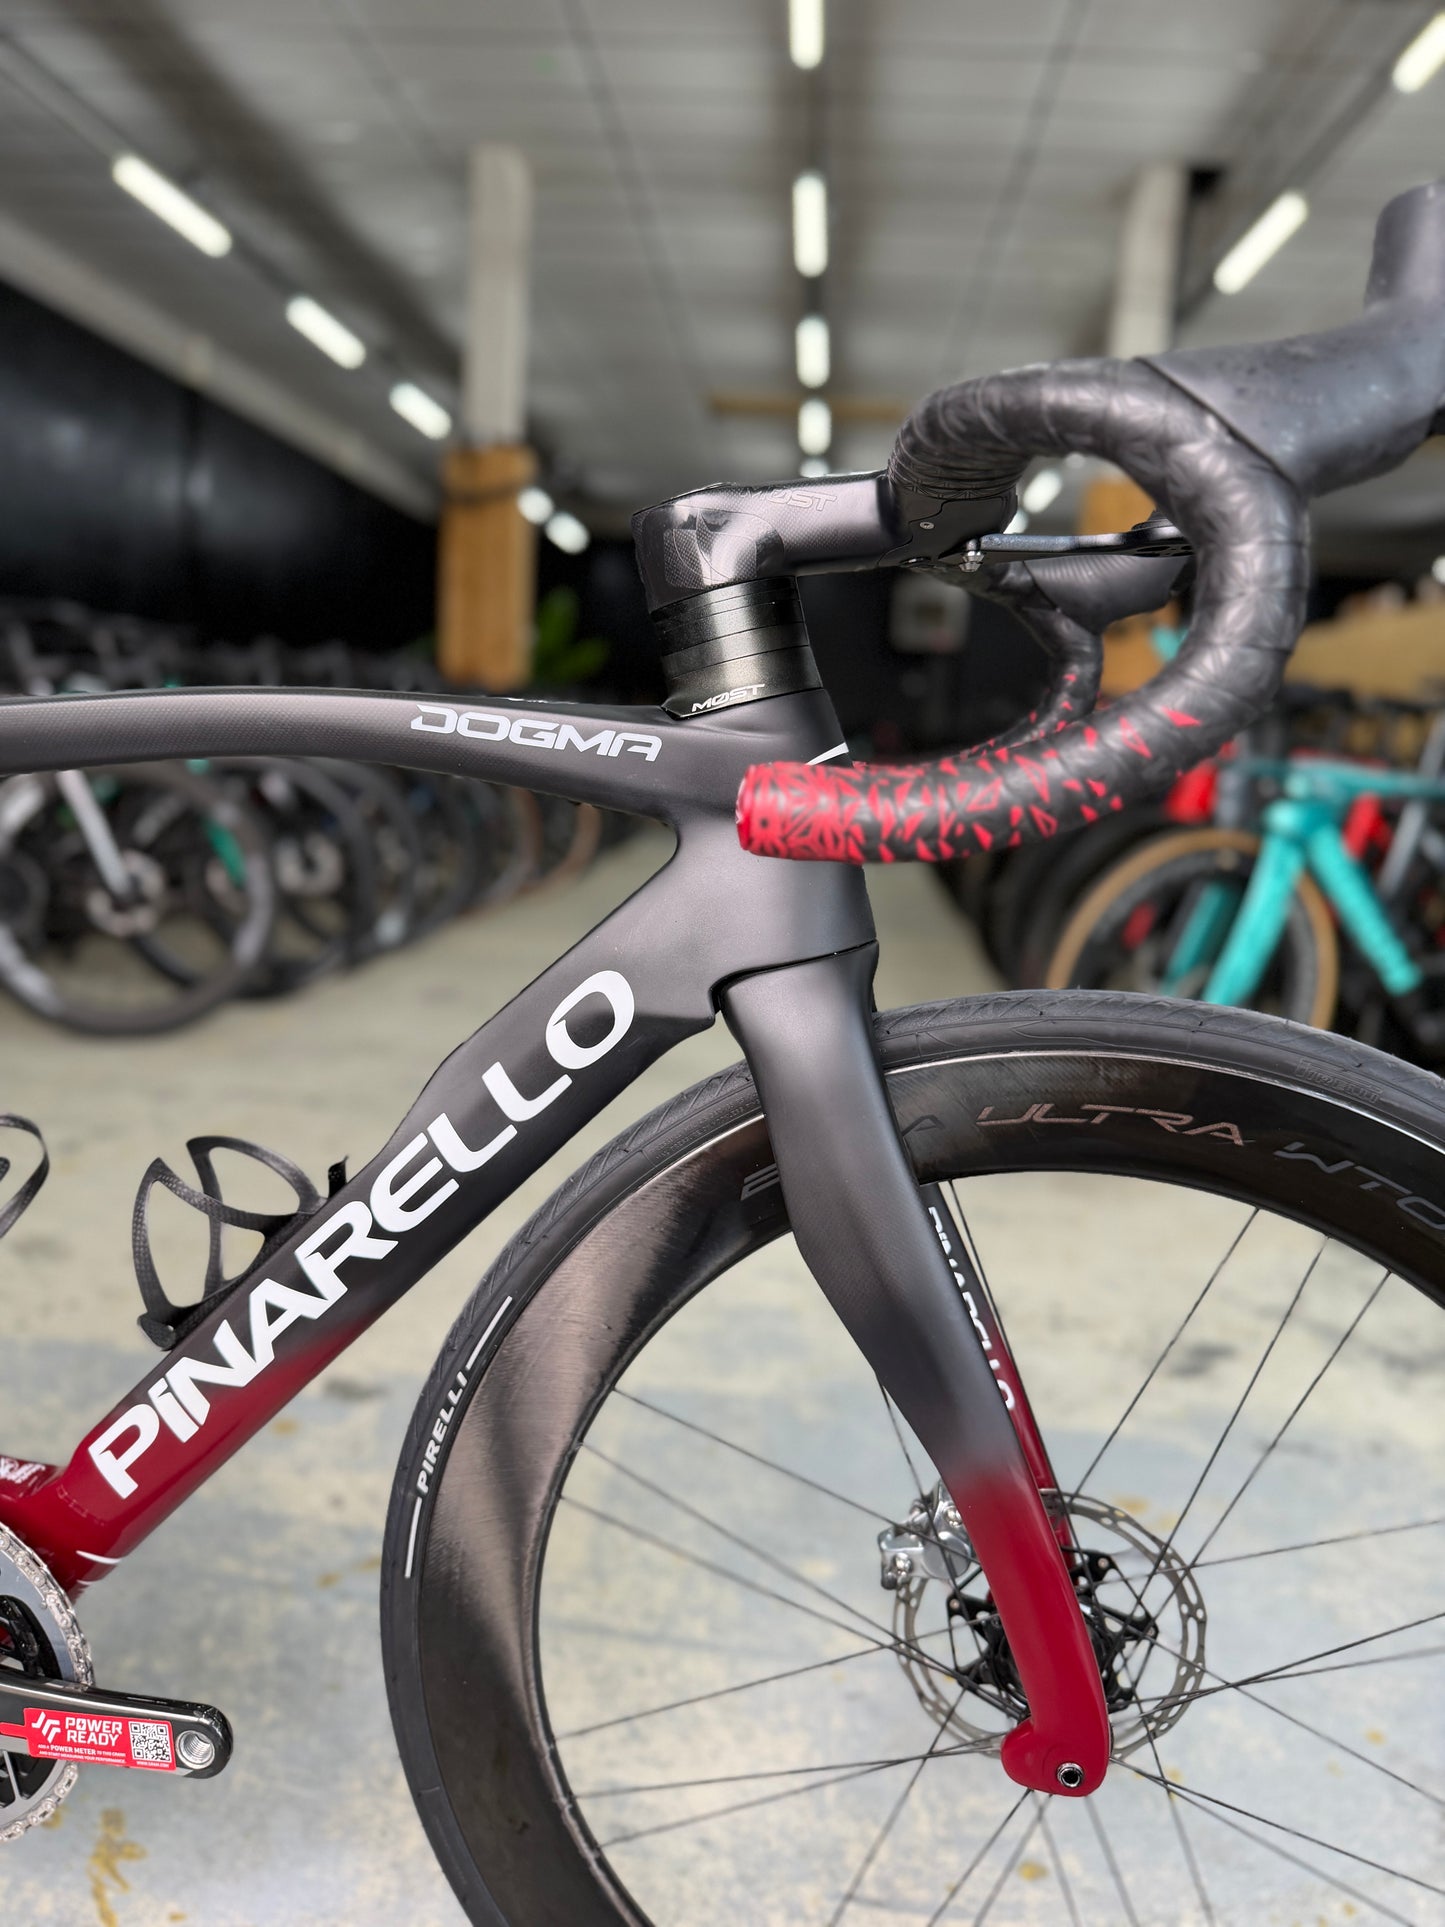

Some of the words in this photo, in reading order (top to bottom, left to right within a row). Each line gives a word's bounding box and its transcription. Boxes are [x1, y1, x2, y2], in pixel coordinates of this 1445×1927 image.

[410, 703, 664, 762] DOGMA
[976, 1103, 1245, 1147] ULTRA
[416, 1371, 468, 1494] PIRELLI
[65, 1716, 123, 1735] POWER
[66, 1729, 119, 1747] READY
[50, 1745, 74, 1753] POWER
[74, 1747, 97, 1755] METER
